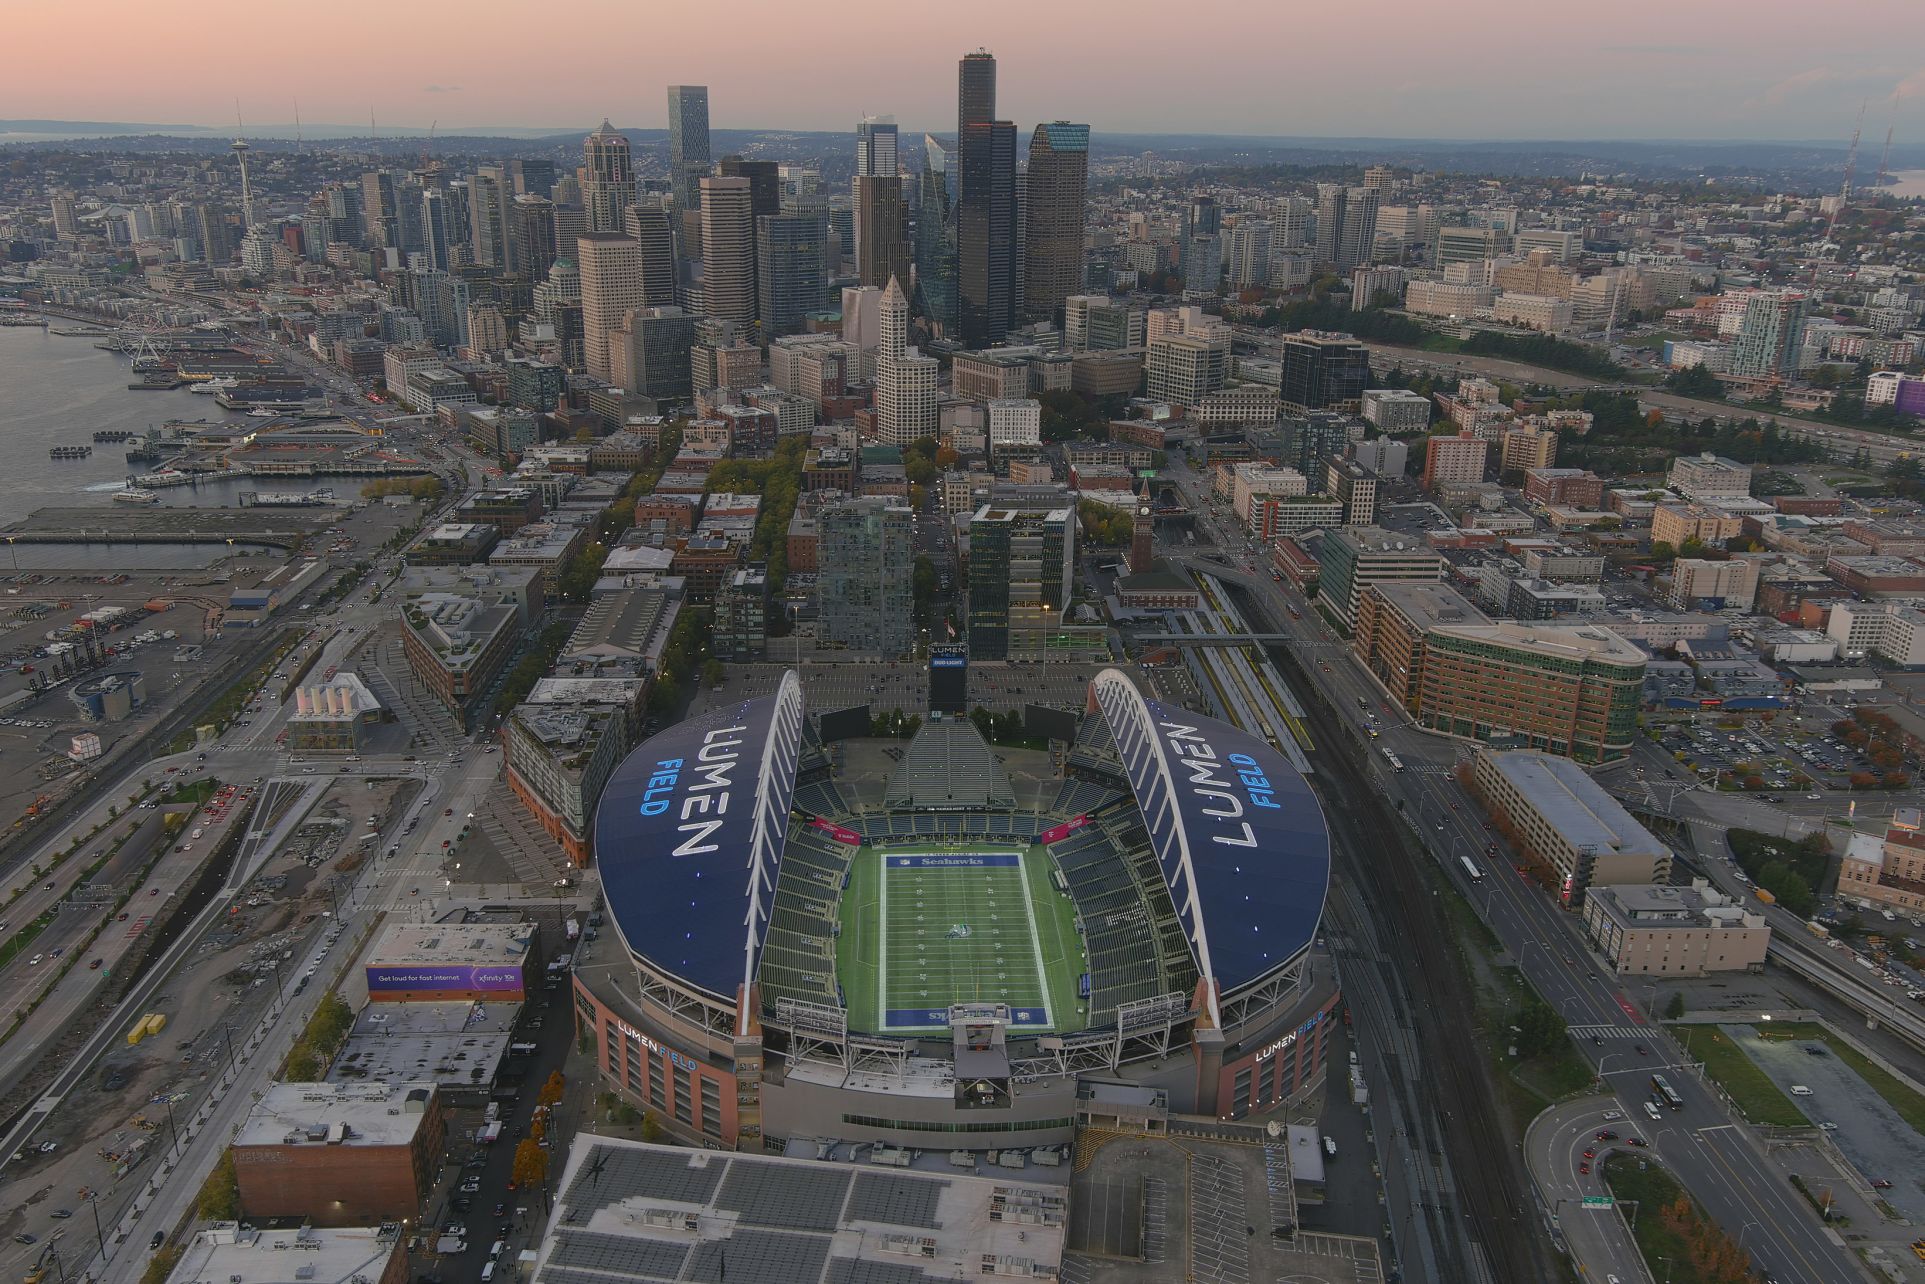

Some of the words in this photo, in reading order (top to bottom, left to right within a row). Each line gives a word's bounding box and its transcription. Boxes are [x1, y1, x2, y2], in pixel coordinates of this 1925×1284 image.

[640, 758, 684, 816] FIELD
[672, 726, 747, 857] LUMEN
[1160, 722, 1258, 848] LUMEN
[1228, 753, 1281, 808] FIELD
[479, 974, 503, 983] xfinity
[617, 1019, 658, 1053] LUMEN
[660, 1045, 698, 1071] FIELD
[1255, 1030, 1297, 1062] LUMEN
[1298, 1011, 1323, 1034] FIELD
